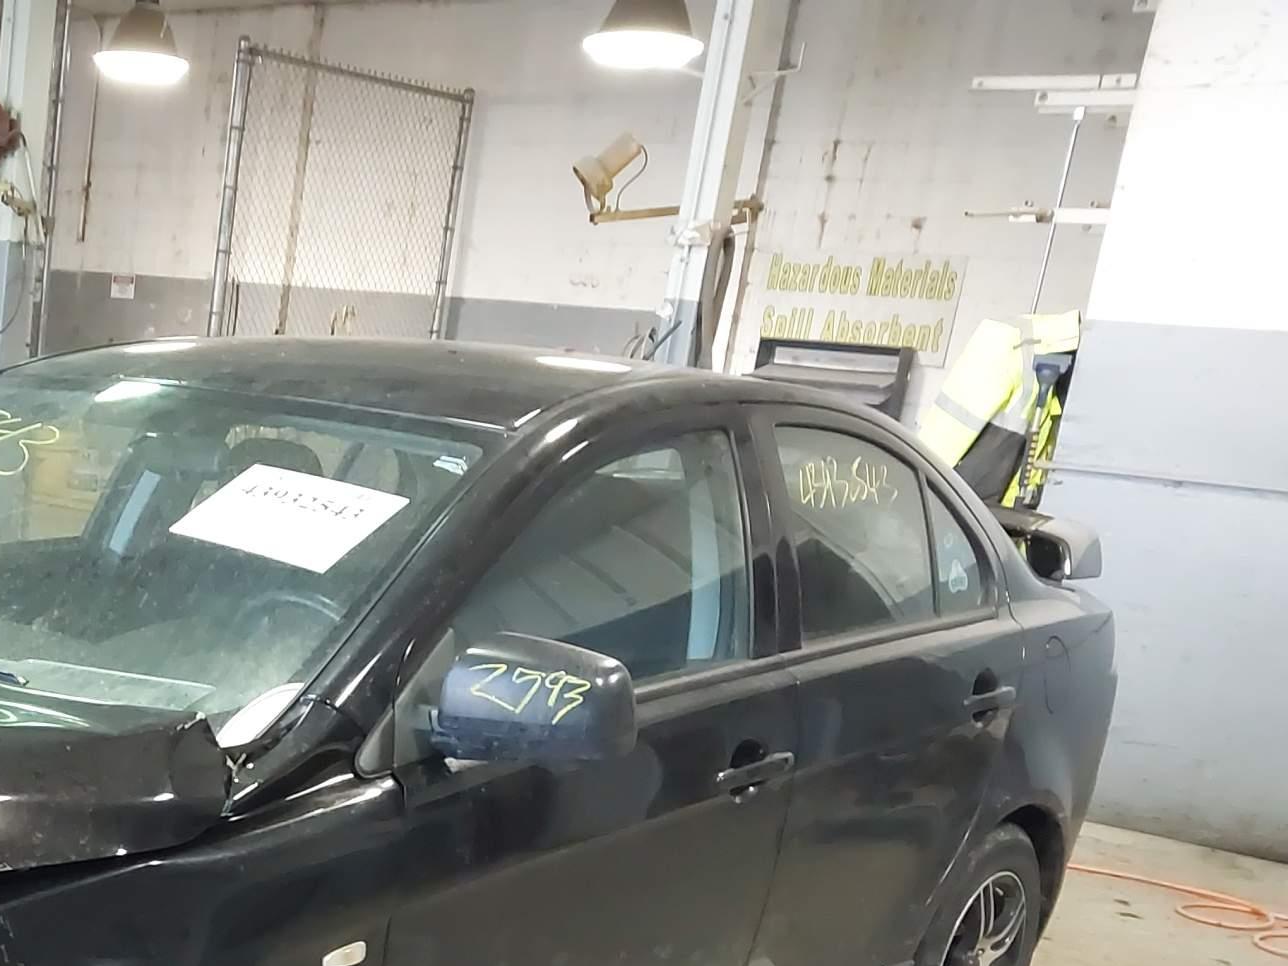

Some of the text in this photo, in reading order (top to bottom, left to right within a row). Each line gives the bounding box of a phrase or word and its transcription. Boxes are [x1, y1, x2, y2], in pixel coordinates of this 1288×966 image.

[766, 253, 958, 301] Hazardous Materials
[760, 304, 945, 353] Spill Absorbent
